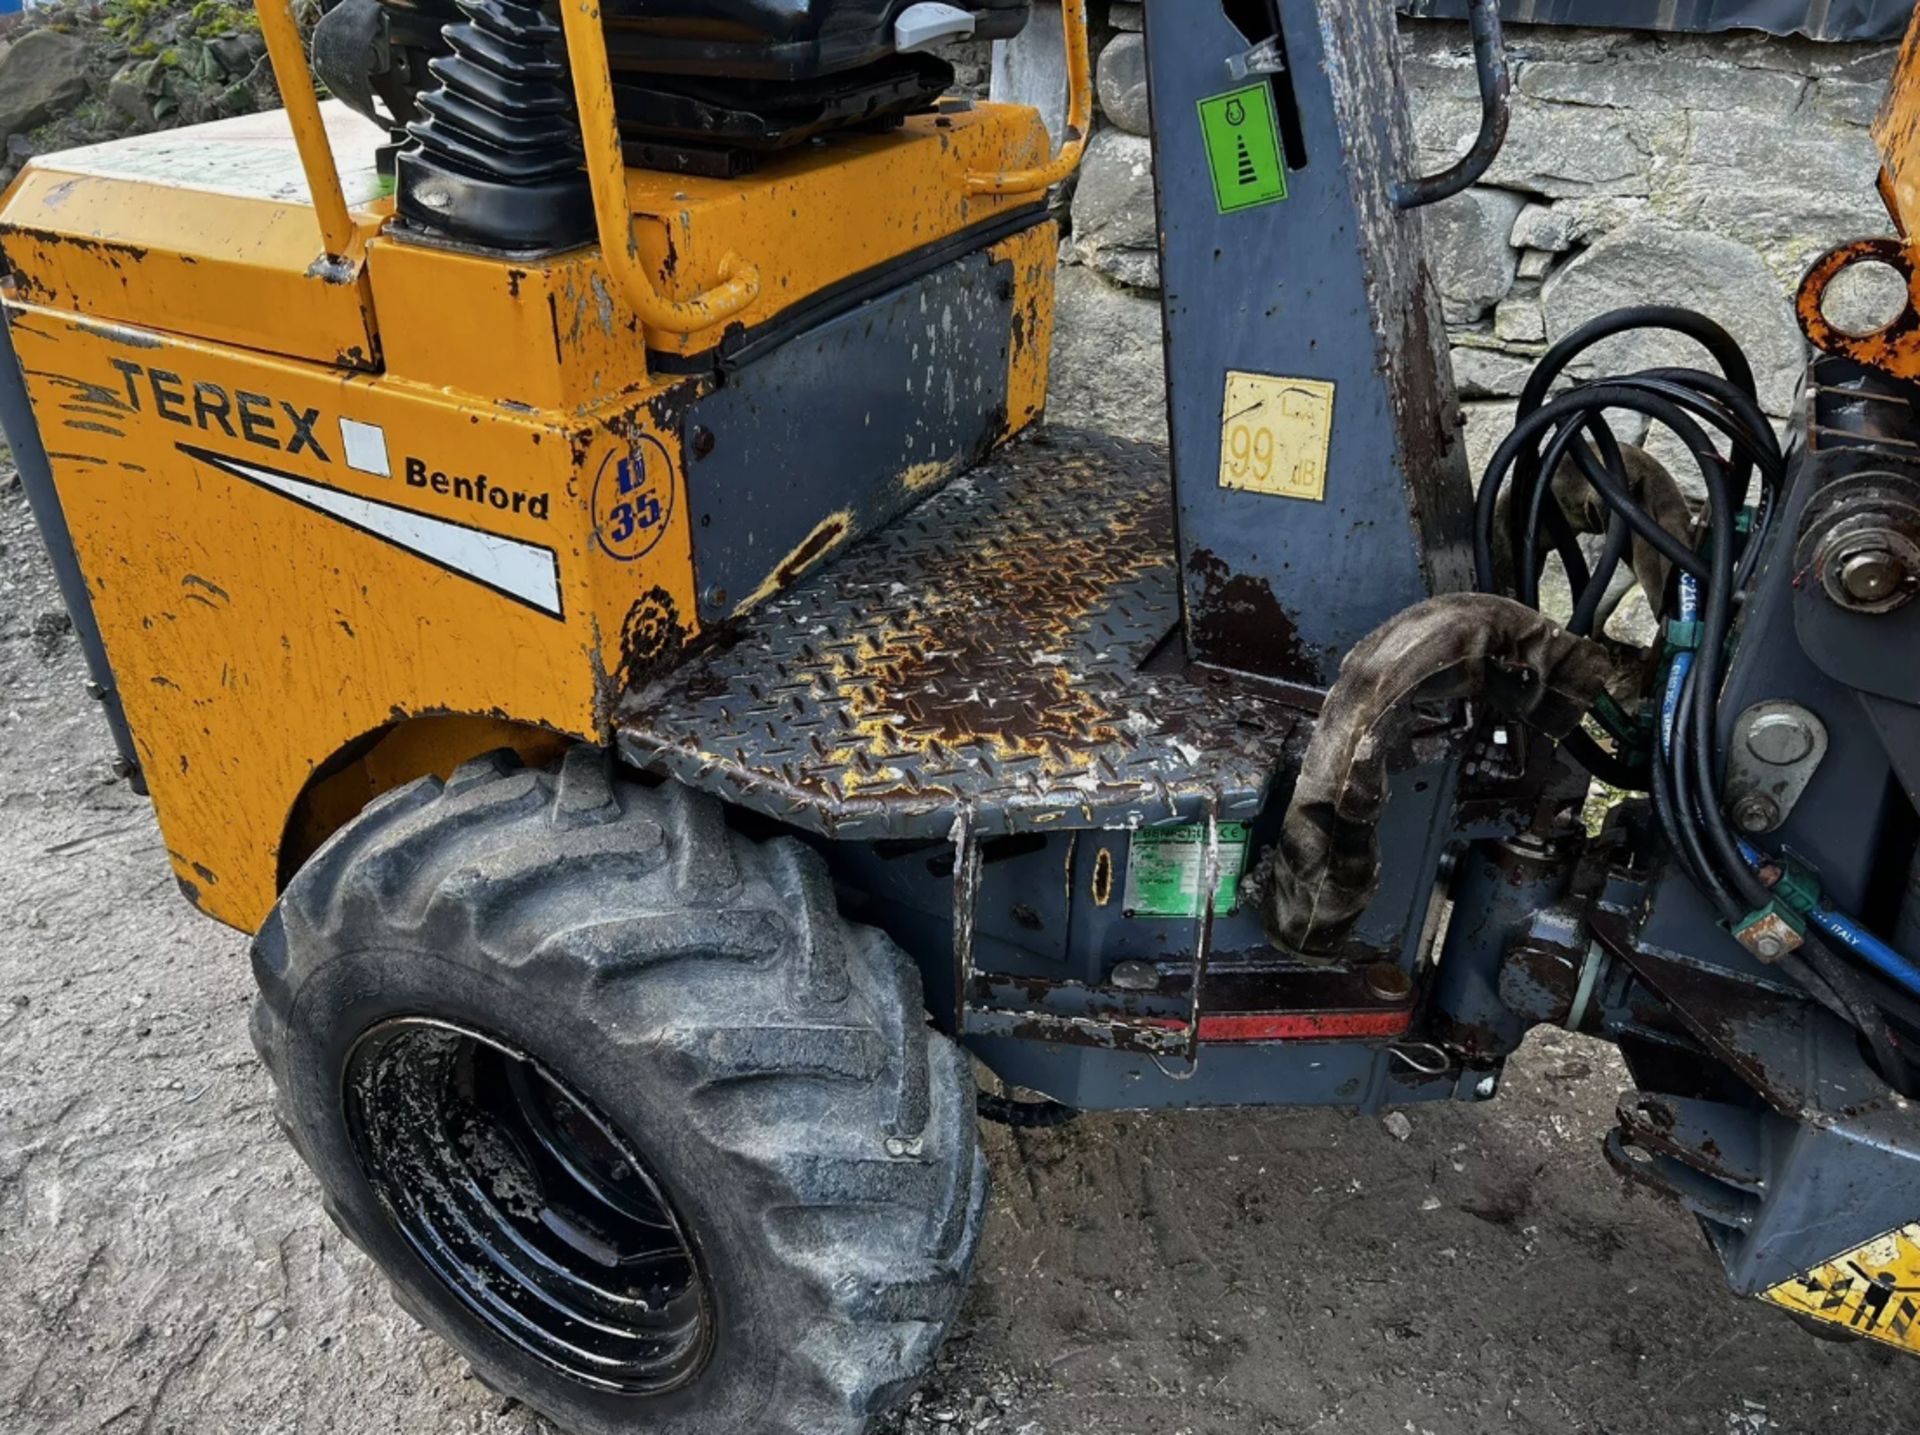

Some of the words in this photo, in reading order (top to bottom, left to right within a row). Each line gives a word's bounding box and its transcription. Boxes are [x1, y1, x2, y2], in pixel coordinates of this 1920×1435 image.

[111, 356, 332, 463] TEREX
[1229, 424, 1273, 481] 99
[405, 456, 549, 520] Benford
[609, 488, 660, 543] 35
[1830, 923, 1859, 946] ITALY
